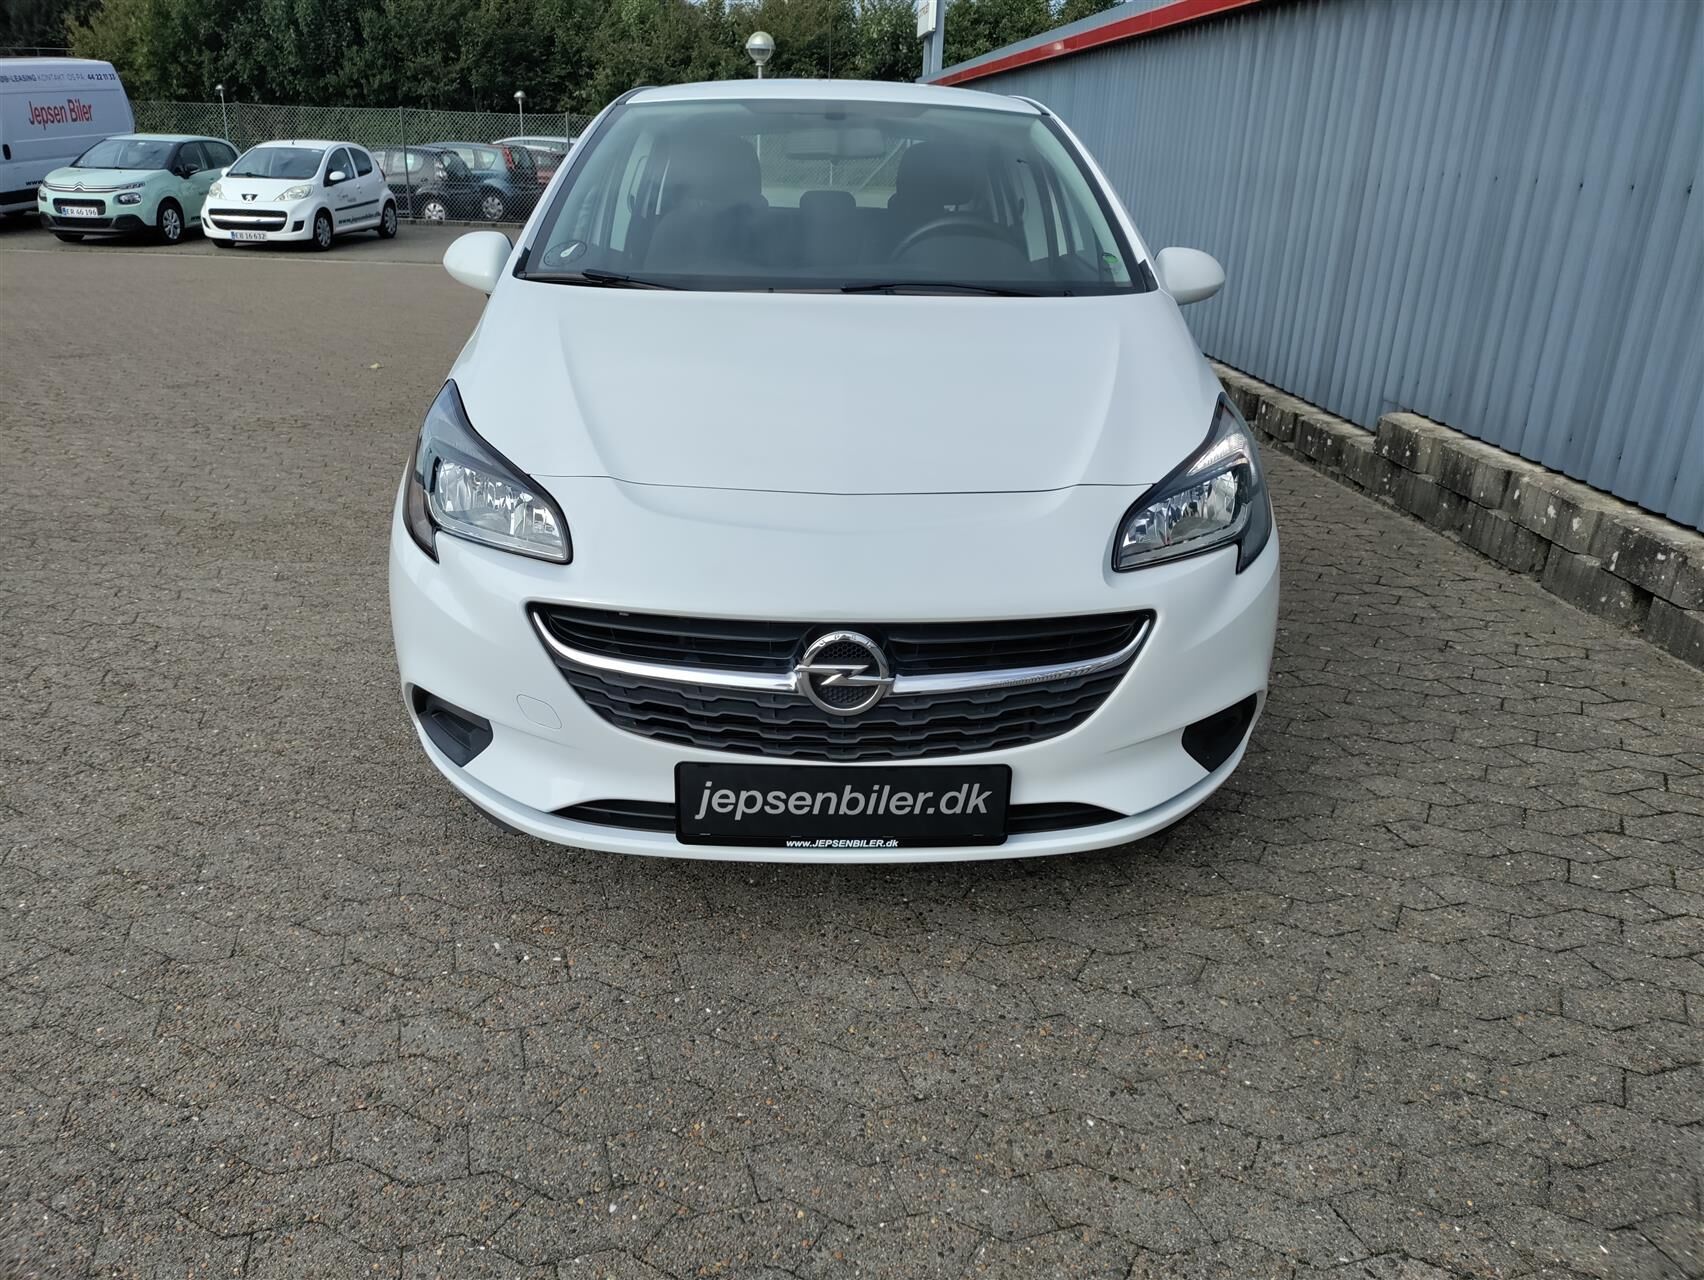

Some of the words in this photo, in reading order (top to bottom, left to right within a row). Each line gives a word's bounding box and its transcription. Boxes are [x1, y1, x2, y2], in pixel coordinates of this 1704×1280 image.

[28, 101, 67, 130] Jepsen
[67, 99, 93, 122] Biler
[85, 208, 97, 216] 196
[695, 781, 993, 820] jepsenbiler.dk
[786, 839, 899, 848] www.JEPSENBILER.dk
